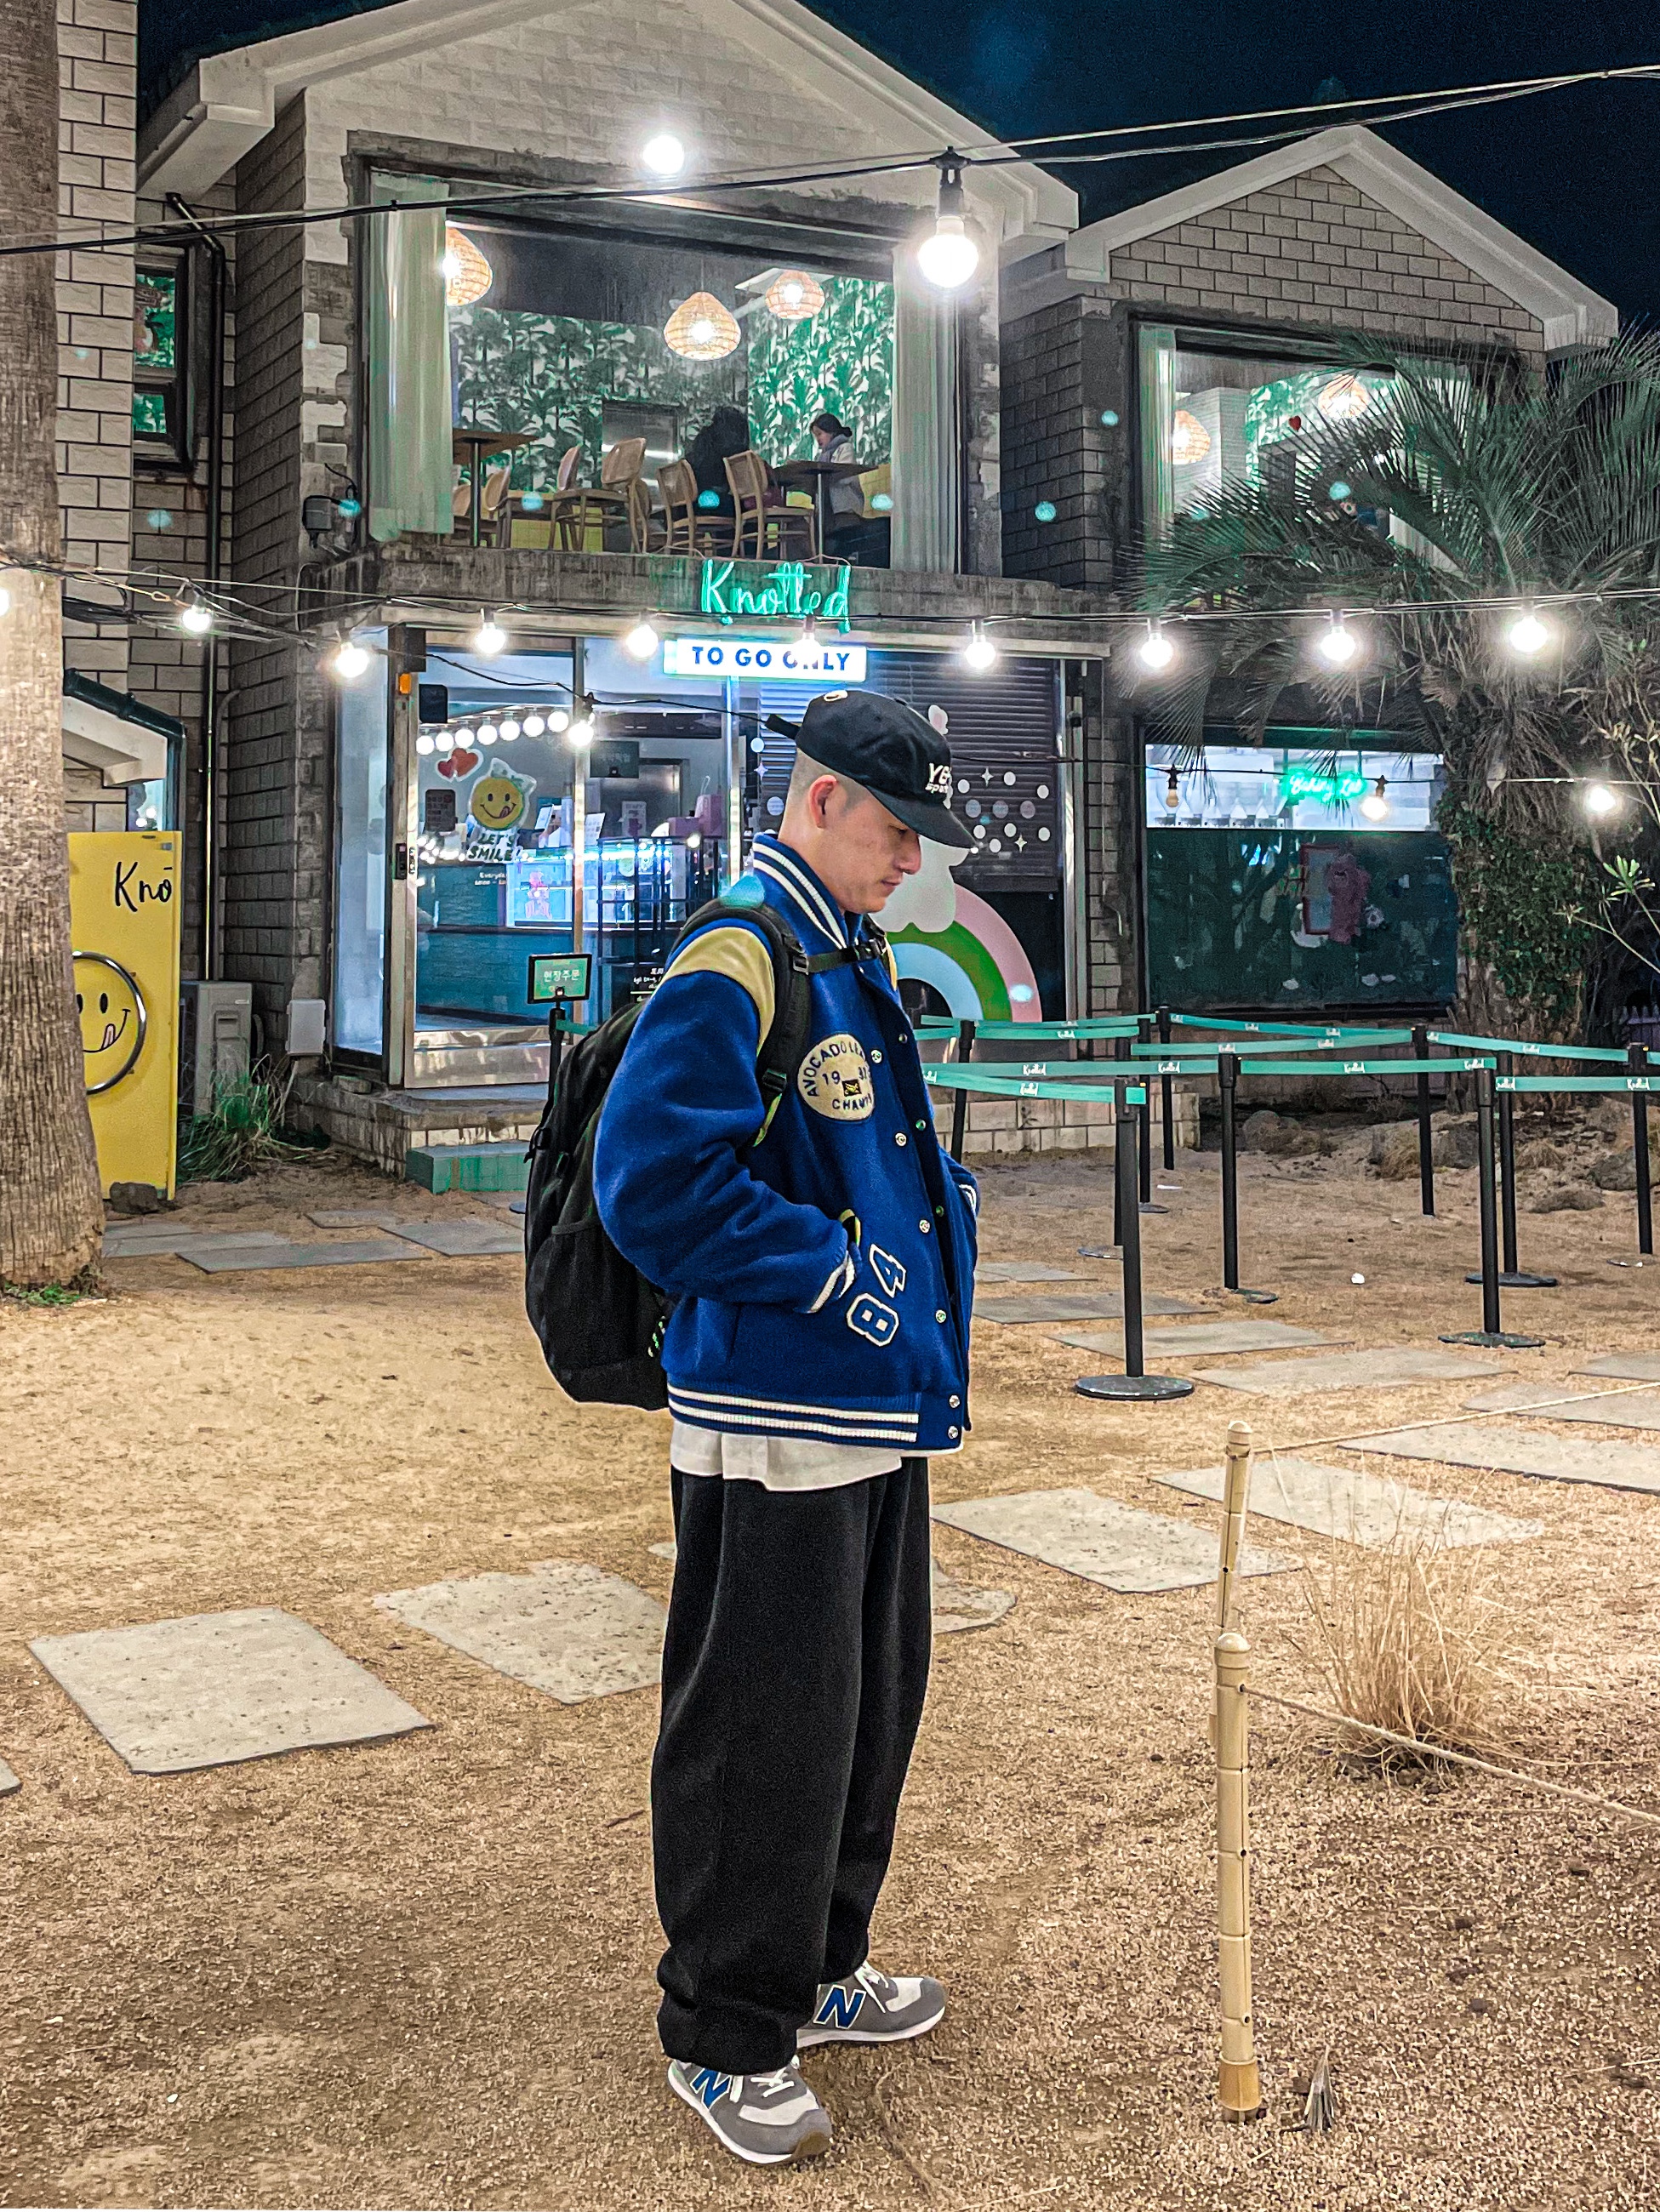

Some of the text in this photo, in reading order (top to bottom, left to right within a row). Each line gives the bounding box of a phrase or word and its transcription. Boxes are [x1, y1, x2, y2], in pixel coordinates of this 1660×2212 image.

[701, 559, 851, 632] Knotted
[692, 646, 723, 665] TO
[735, 648, 772, 667] GO
[802, 1040, 847, 1097] AVOCADO
[822, 1070, 841, 1086] 19
[846, 1242, 907, 1348] 84
[813, 1983, 867, 2030] N
[689, 2069, 733, 2110] N
